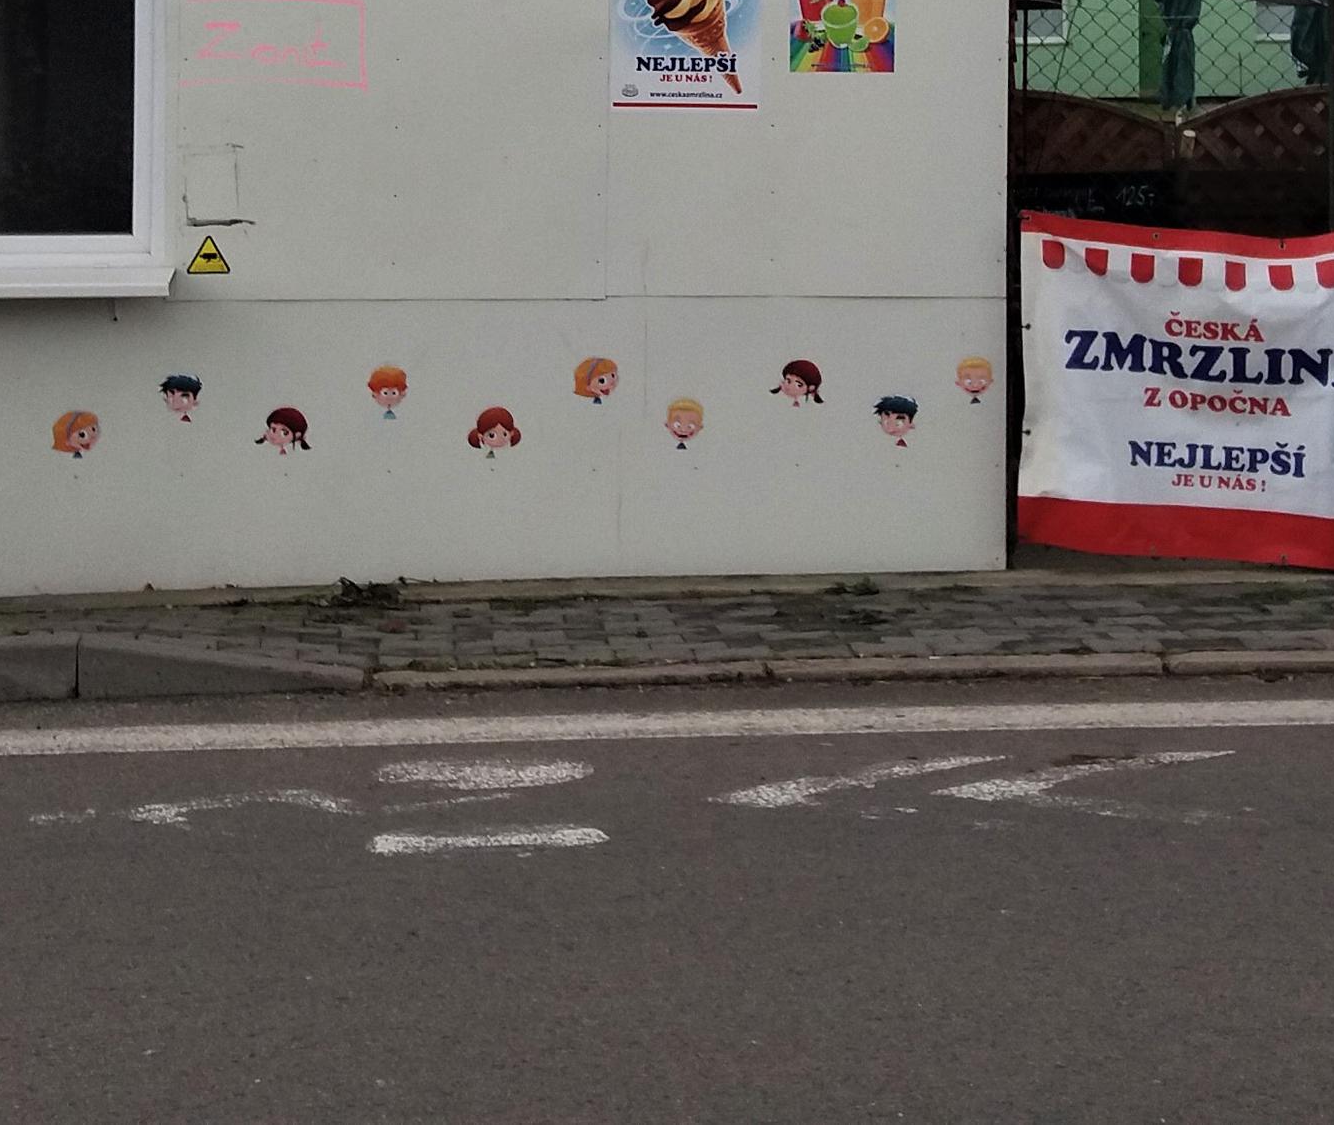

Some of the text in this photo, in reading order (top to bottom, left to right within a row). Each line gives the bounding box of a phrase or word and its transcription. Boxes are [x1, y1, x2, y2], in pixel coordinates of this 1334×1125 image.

[636, 53, 737, 73] NEJLEPŠÍ
[659, 74, 673, 83] JE
[675, 74, 683, 83] U
[1164, 311, 1265, 343] ČESKÁ
[1143, 388, 1292, 417] Z OPOČNA
[1127, 441, 1307, 478] NEJLEPŠÍ
[1171, 474, 1195, 488] JE
[1199, 475, 1213, 488] U
